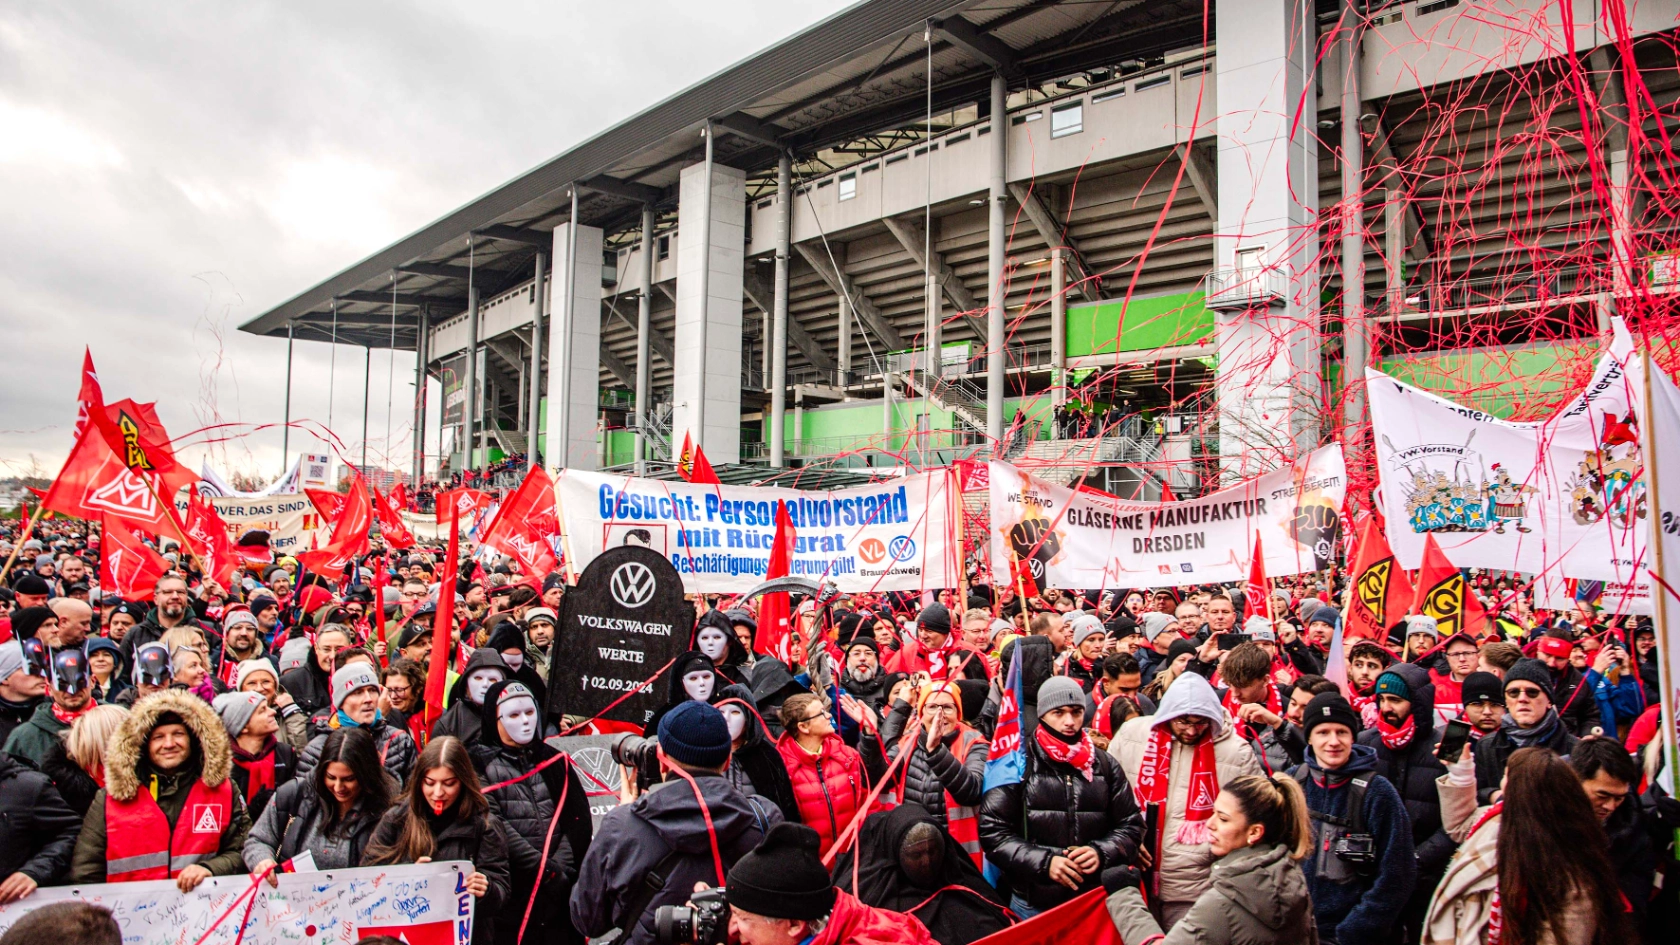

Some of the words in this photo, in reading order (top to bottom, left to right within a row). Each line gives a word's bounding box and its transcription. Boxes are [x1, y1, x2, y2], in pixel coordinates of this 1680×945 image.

[278, 501, 305, 514] SIND
[599, 483, 701, 522] Gesucht:
[1008, 493, 1021, 503] WE
[1024, 495, 1053, 508] STAND
[1067, 506, 1144, 530] GLÄSERNE
[1150, 498, 1268, 529] MANUFAKTUR
[677, 527, 722, 548] mit
[727, 529, 846, 554] Rücgrat
[1133, 532, 1206, 554] DRESDEN
[832, 556, 856, 577] gilt!
[860, 566, 921, 577] Braunschweig
[577, 615, 672, 637] VOLKSWAGEN
[598, 647, 645, 664] WERTE
